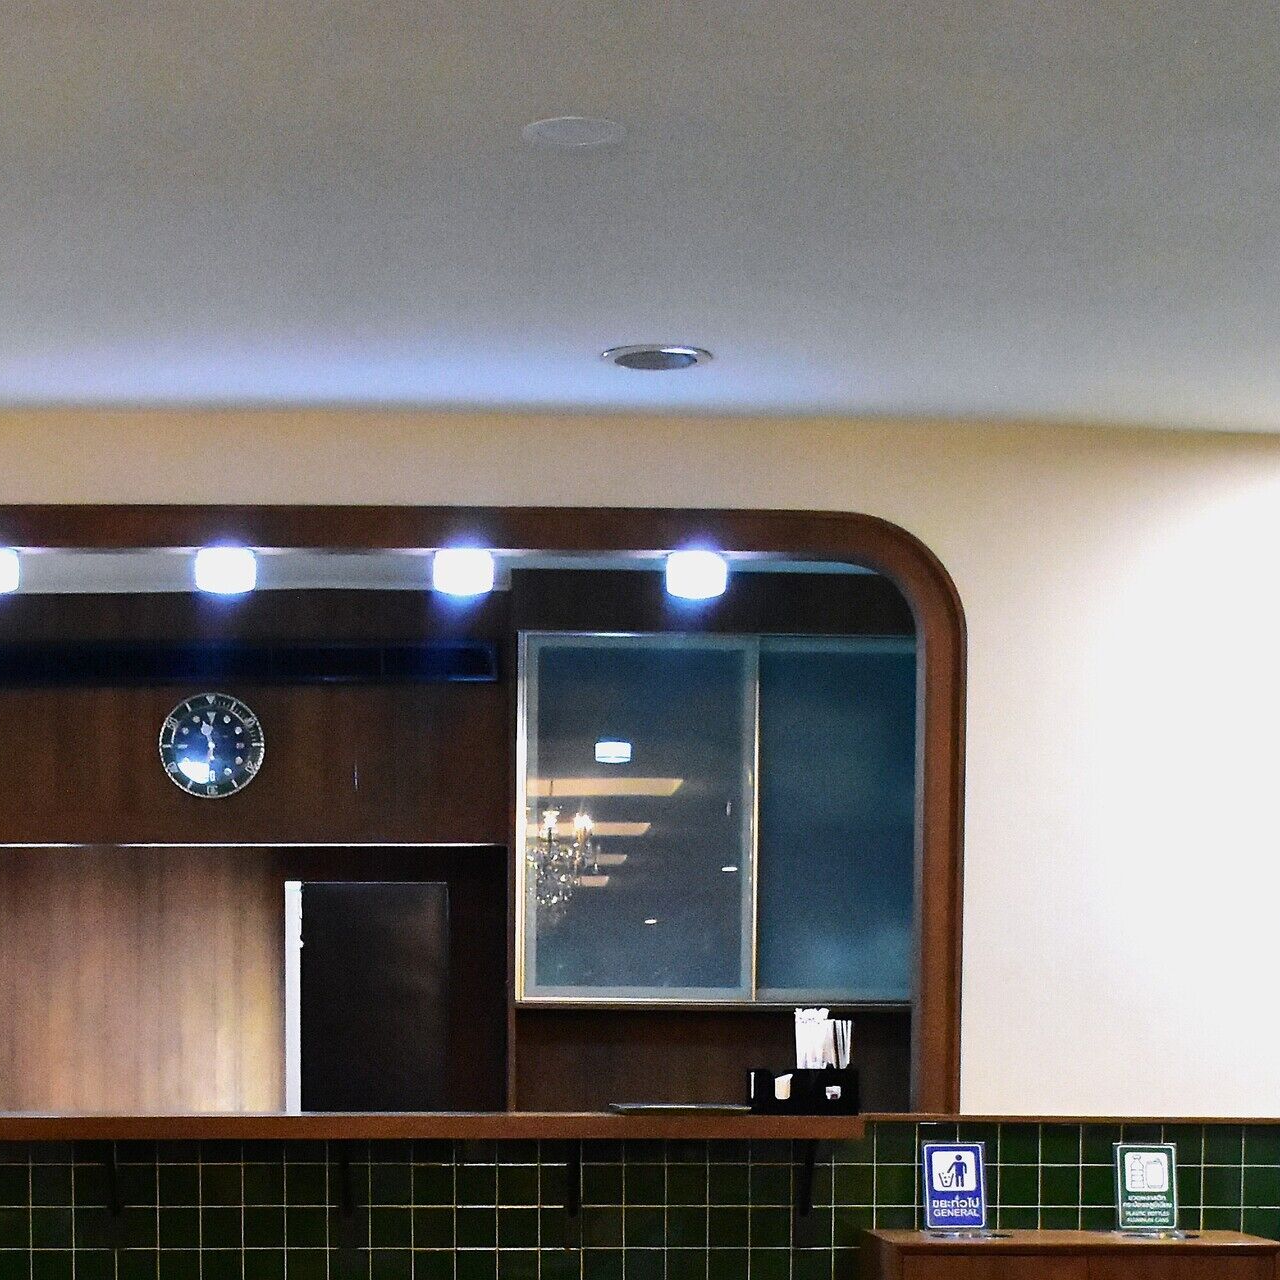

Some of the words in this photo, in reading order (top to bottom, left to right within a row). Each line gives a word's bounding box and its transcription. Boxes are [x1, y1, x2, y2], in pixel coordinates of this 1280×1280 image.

[932, 1194, 980, 1208] ขยะทั่วไป
[933, 1208, 980, 1217] GENERAL
